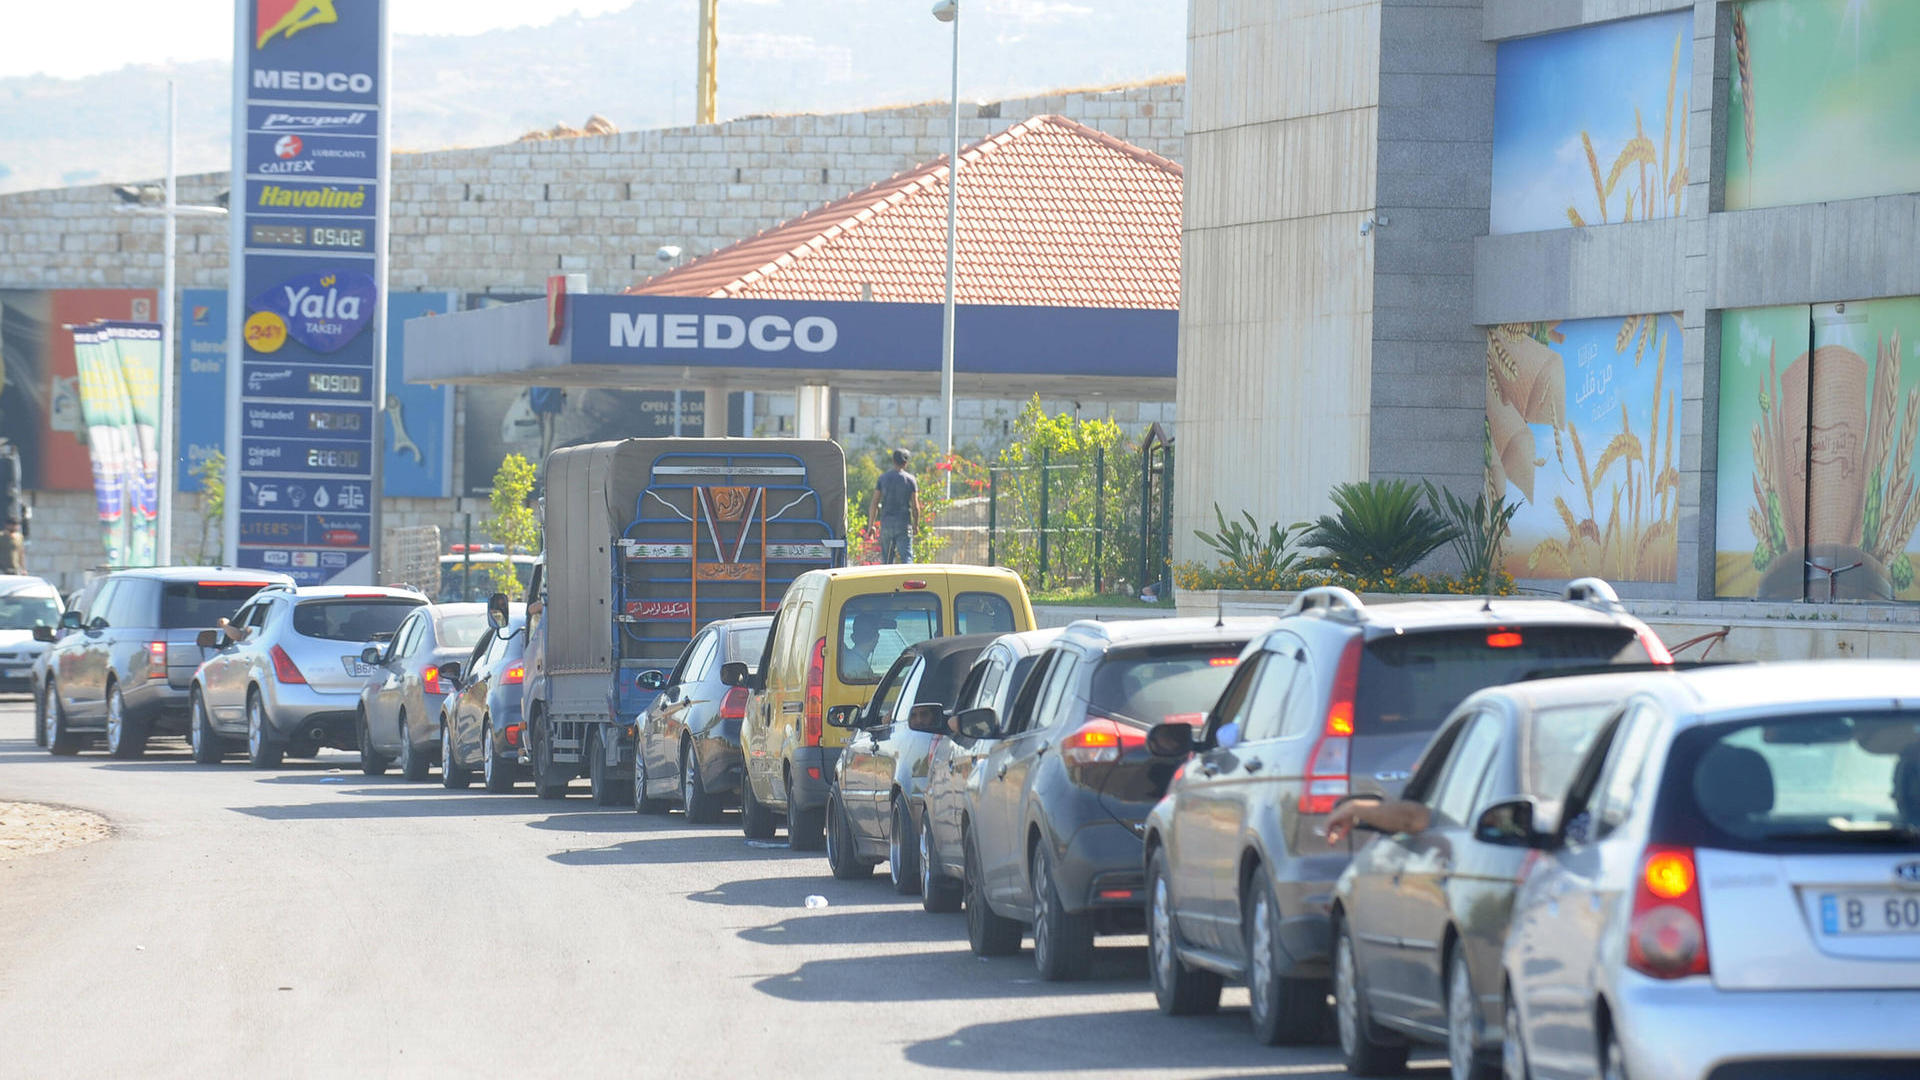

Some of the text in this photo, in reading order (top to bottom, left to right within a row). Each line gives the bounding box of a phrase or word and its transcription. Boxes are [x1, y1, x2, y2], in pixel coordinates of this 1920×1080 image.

[254, 69, 373, 93] MEDCO
[262, 112, 367, 128] Propell
[311, 149, 366, 158] LUBRICANTS
[259, 159, 315, 173] CALTEX
[258, 185, 365, 208] Havoline
[284, 286, 361, 320] Yala
[610, 313, 838, 352] MEDCO
[641, 401, 669, 412] OPEN
[671, 401, 688, 412] 35
[249, 410, 294, 420] Unleaded
[669, 415, 703, 425] HURS
[248, 447, 281, 457] Diesel
[1846, 899, 1863, 929] B
